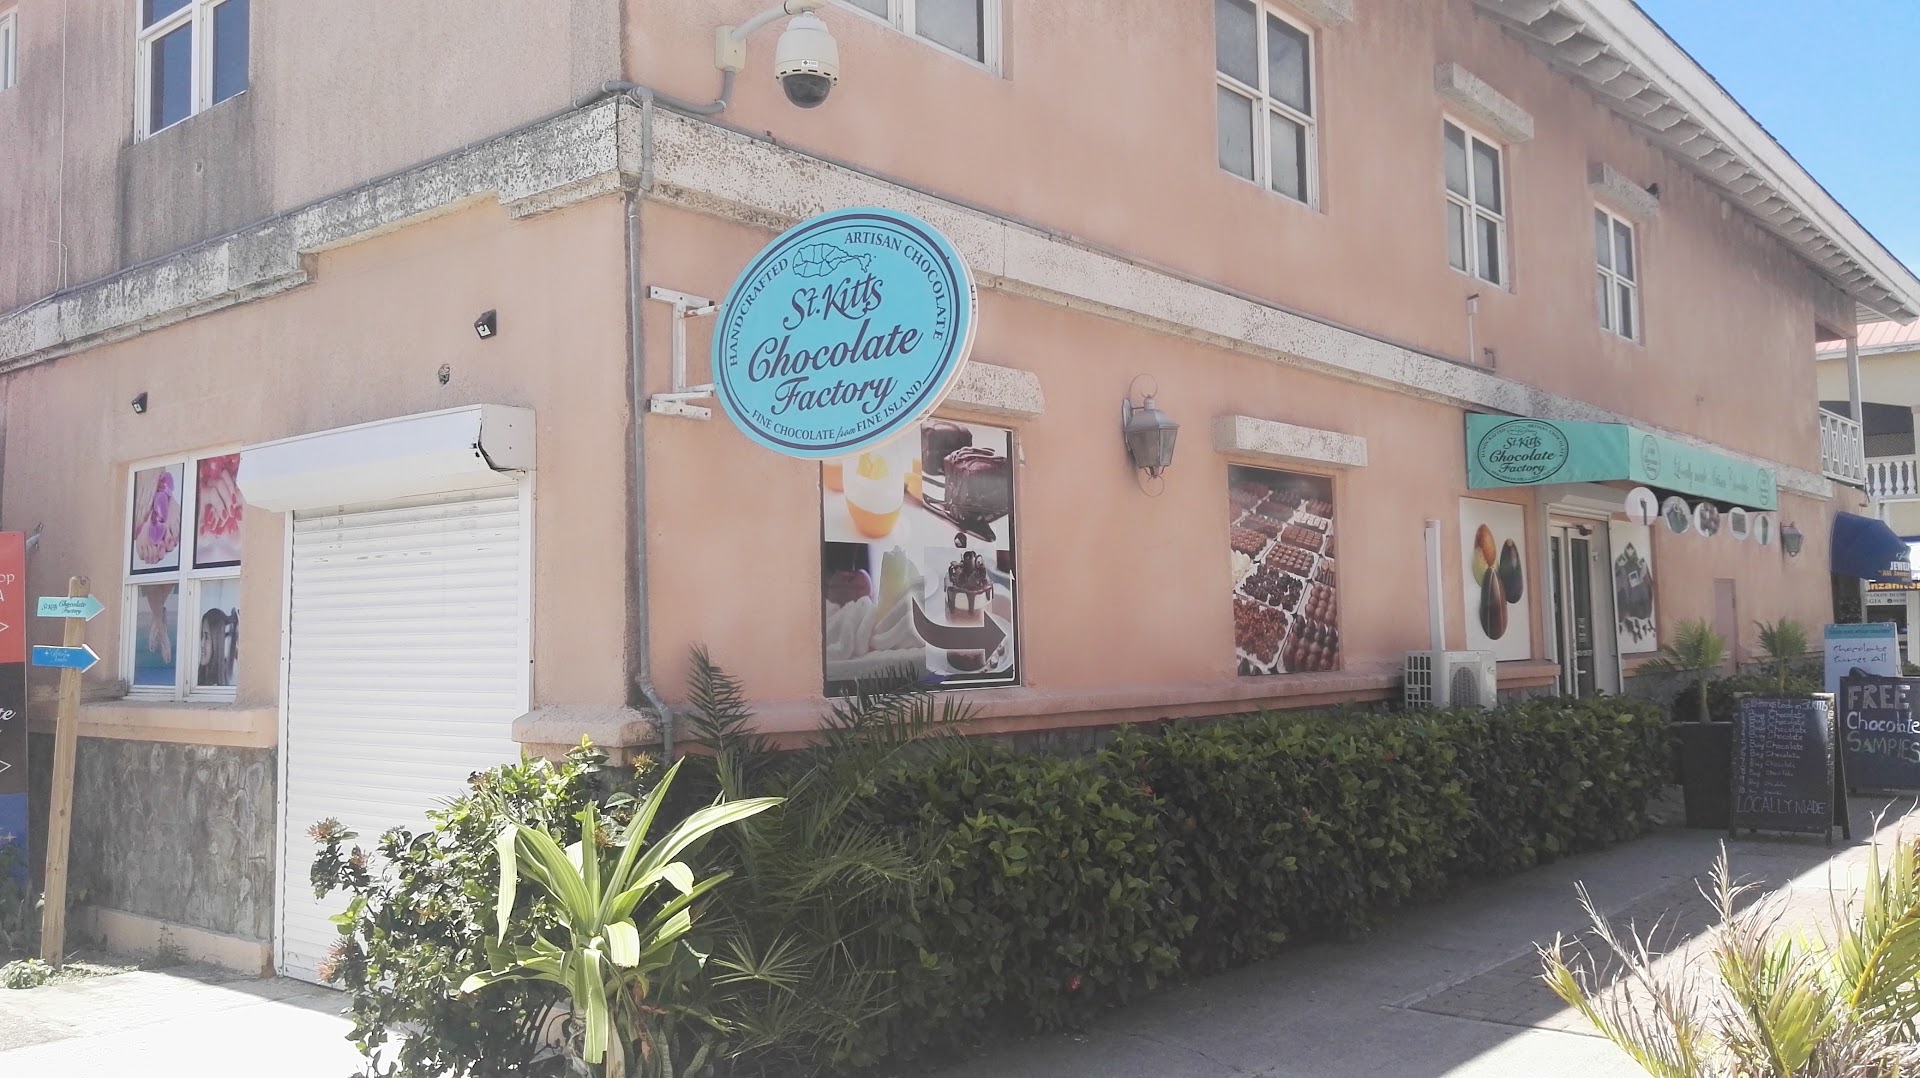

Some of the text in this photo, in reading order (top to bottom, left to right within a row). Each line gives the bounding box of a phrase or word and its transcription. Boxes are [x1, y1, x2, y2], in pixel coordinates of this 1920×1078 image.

[844, 231, 902, 251] ARTISAN
[904, 245, 947, 340] CHOCOLATE
[730, 258, 788, 367] HANDCRAFTED
[748, 318, 924, 382] Chocolate
[751, 380, 922, 442] FINE CHOCOLATE from FINE ISLAND
[771, 376, 898, 415] Factory
[1489, 449, 1556, 463] Chocolate
[1498, 462, 1545, 475] Factory
[1847, 684, 1911, 710] FREE
[1846, 711, 1920, 734] Chocolate
[1736, 795, 1827, 814] LOCALLY MADE
